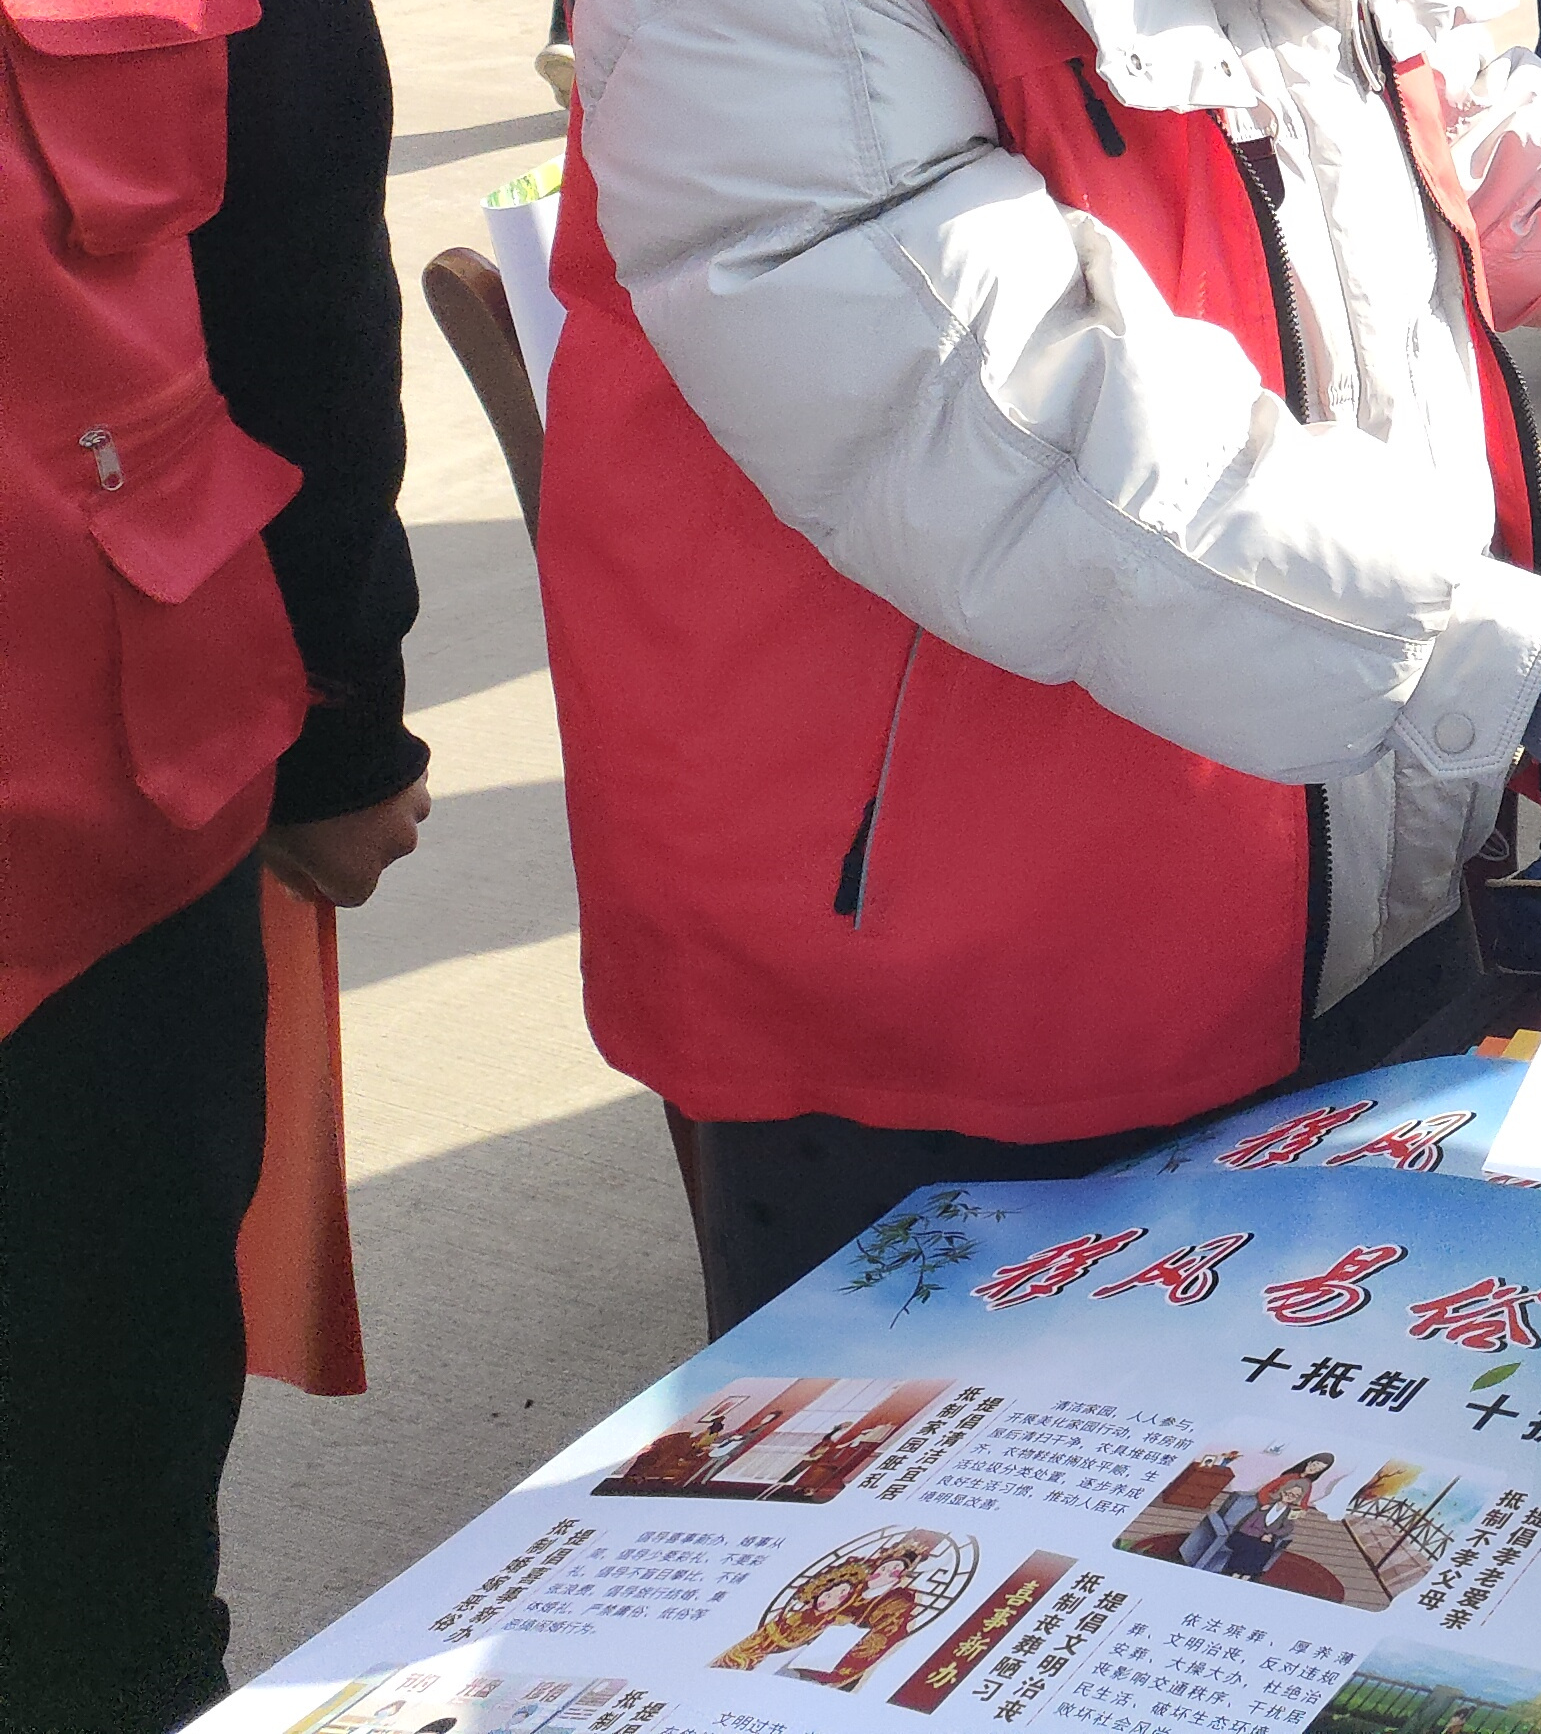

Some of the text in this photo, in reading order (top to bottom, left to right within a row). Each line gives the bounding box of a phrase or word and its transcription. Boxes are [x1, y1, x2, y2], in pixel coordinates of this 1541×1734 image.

[1240, 1348, 1429, 1412] 十抵制
[858, 1385, 985, 1491] 抵制家园脏乱
[876, 1396, 1004, 1501] 提倡清洁宜居
[429, 1517, 579, 1632] 抵制婚嫁恶俗
[443, 1528, 596, 1643] 提倡喜事新办
[1418, 1490, 1528, 1611] 抵制不孝父母
[925, 1580, 1040, 1689] 喜事新办
[972, 1571, 1105, 1705] 抵制丧葬陋习
[992, 1590, 1129, 1724] 提倡文明治丧
